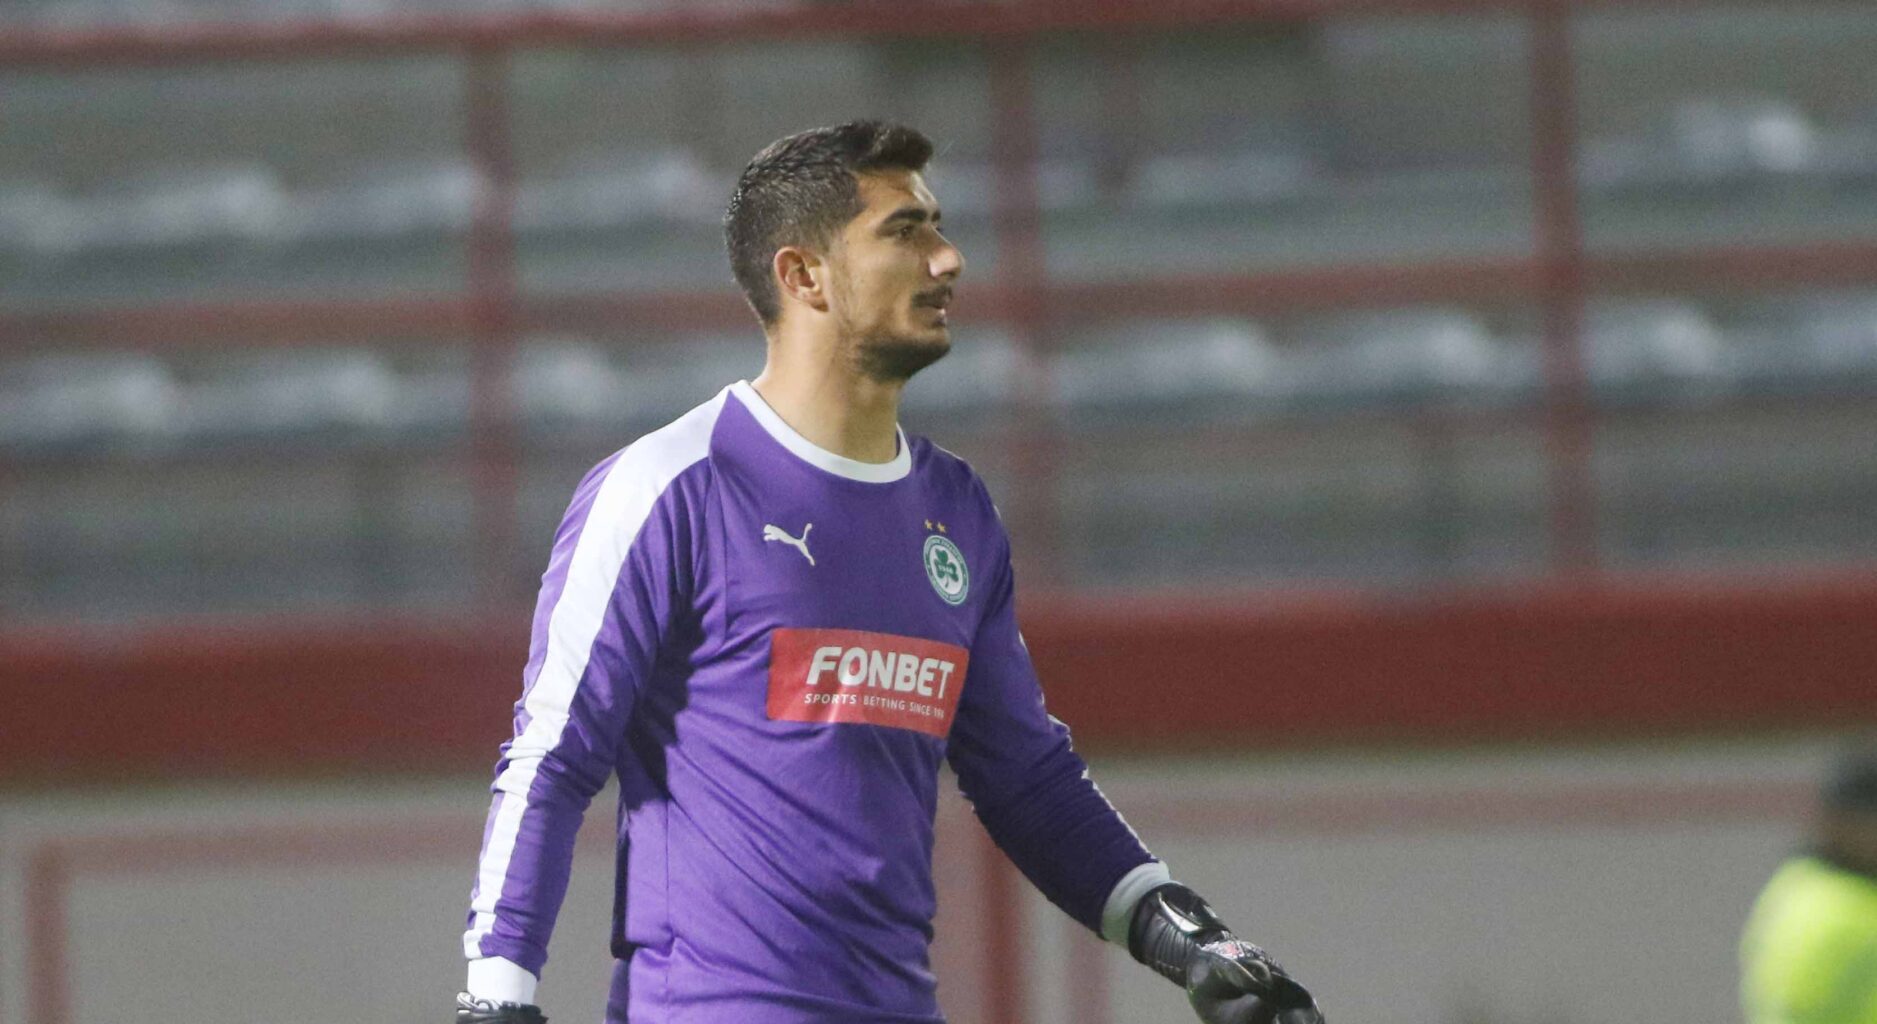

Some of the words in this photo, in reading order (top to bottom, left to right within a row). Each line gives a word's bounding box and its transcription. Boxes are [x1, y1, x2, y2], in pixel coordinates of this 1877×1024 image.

[806, 646, 955, 699] FONBET
[804, 693, 857, 705] SPORTS
[863, 696, 906, 711] BETTING
[909, 701, 931, 716] SINCE
